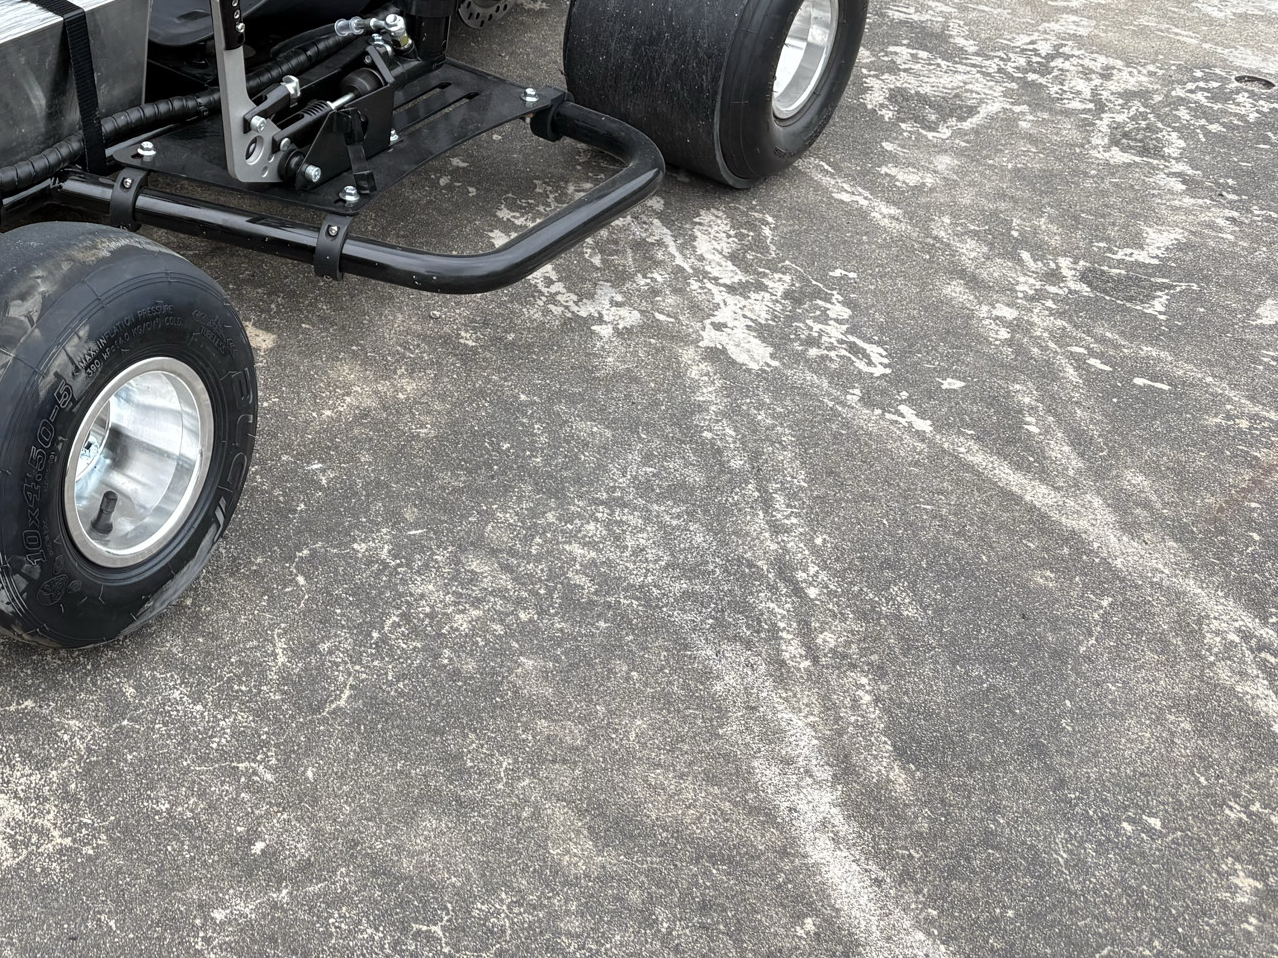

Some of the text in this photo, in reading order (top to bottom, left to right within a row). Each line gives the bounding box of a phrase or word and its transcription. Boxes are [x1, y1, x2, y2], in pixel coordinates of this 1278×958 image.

[96, 313, 136, 349] INFLATION
[137, 304, 175, 321] PRESSURE
[200, 325, 227, 356] TUBELESS
[86, 360, 102, 377] 390
